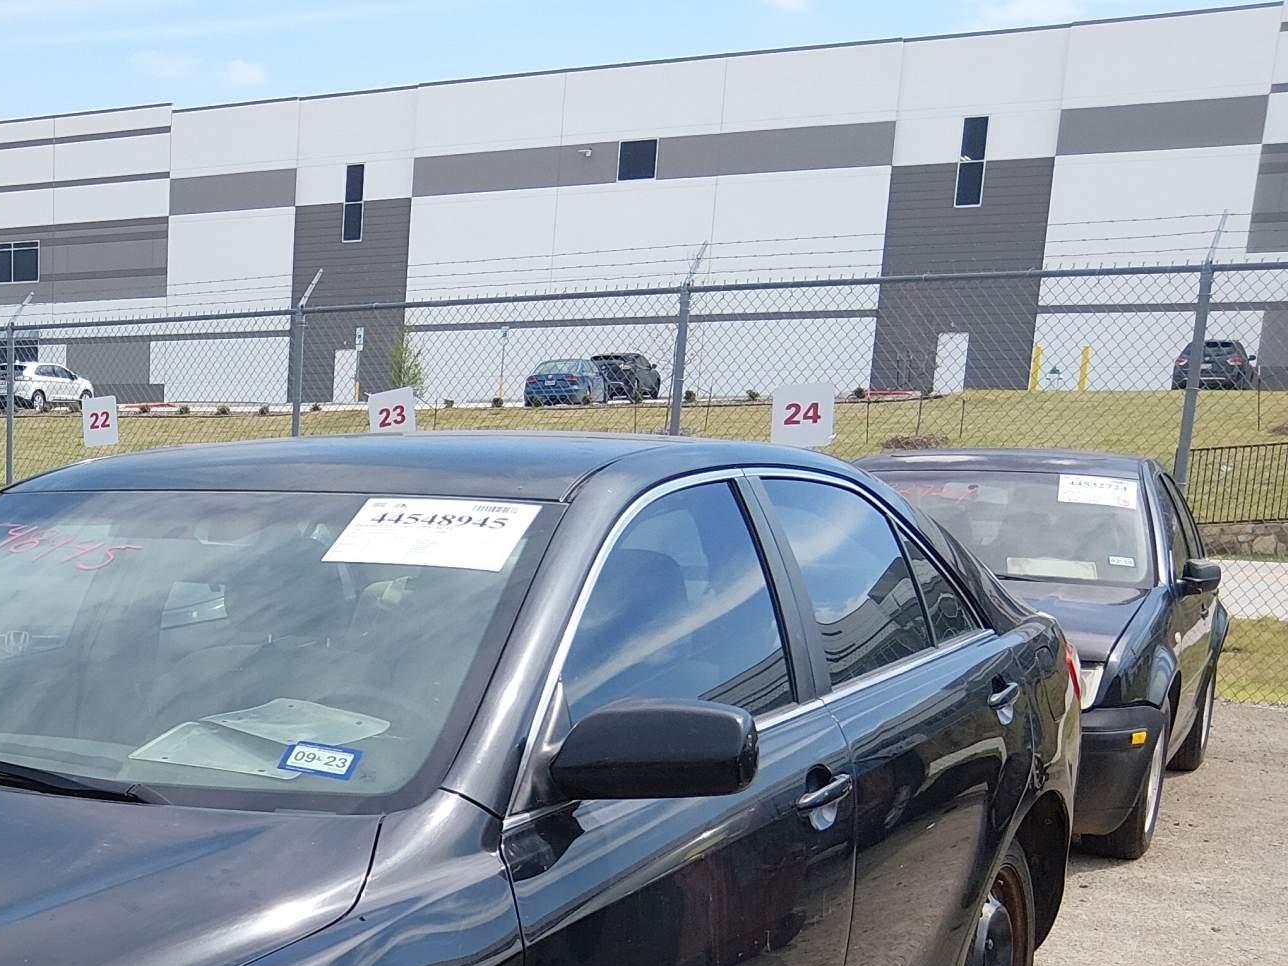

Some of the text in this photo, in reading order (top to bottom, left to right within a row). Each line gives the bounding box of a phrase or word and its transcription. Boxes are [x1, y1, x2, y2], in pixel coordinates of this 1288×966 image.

[89, 411, 111, 430] 22
[378, 404, 406, 428] 23
[783, 402, 822, 426] 24
[370, 511, 510, 530] 44548945
[293, 750, 349, 769] 09 23
